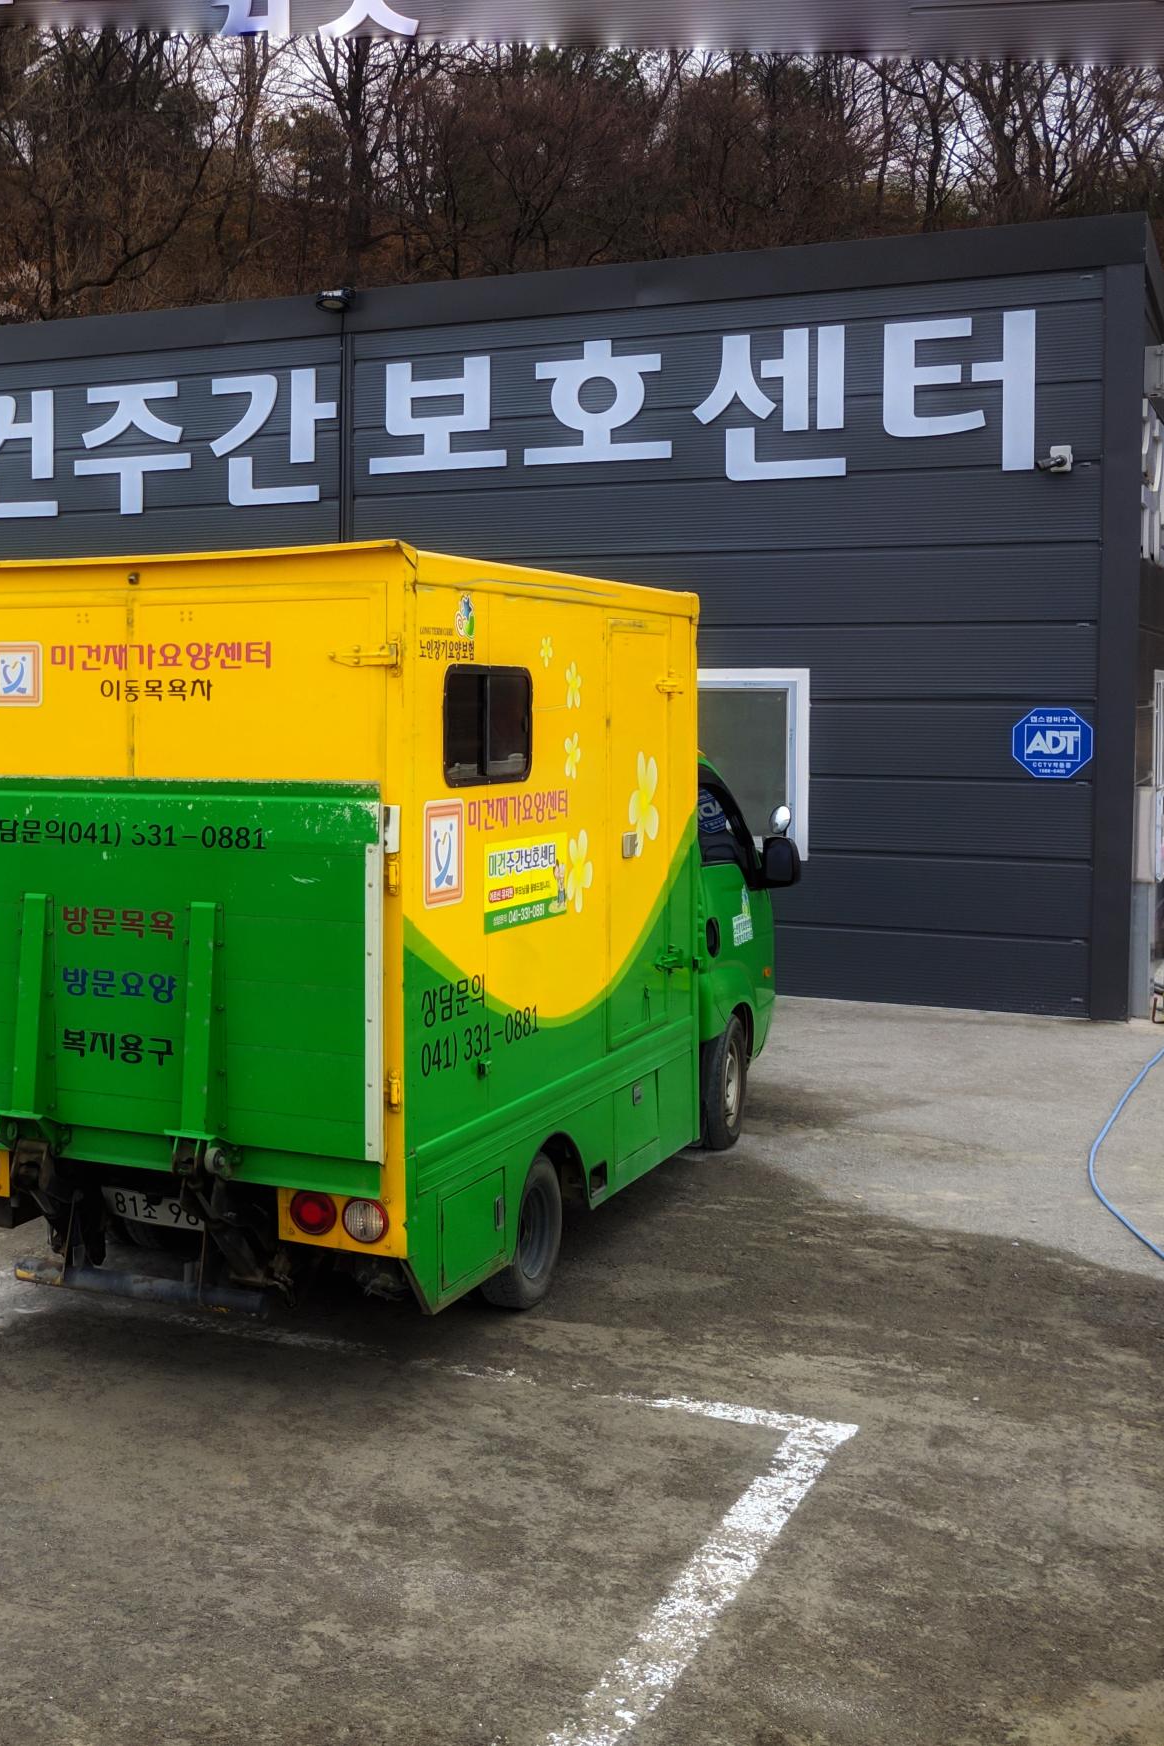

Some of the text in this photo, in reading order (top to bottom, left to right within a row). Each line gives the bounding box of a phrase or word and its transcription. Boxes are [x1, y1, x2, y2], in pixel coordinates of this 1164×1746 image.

[51, 641, 271, 671] 미건재가요양센터
[419, 639, 474, 661] 노인장기요양보험
[100, 678, 213, 702] 이동목욕차
[1026, 730, 1080, 755] ADT
[468, 789, 568, 831] 미건재가요양센터
[488, 844, 556, 877] 미건주간보호센터
[62, 906, 176, 941] 방문목욕
[62, 967, 178, 1004] 방문요양
[421, 973, 485, 1028] 상담문의
[62, 1028, 175, 1066] 복지용구
[421, 1031, 458, 1077] 041)
